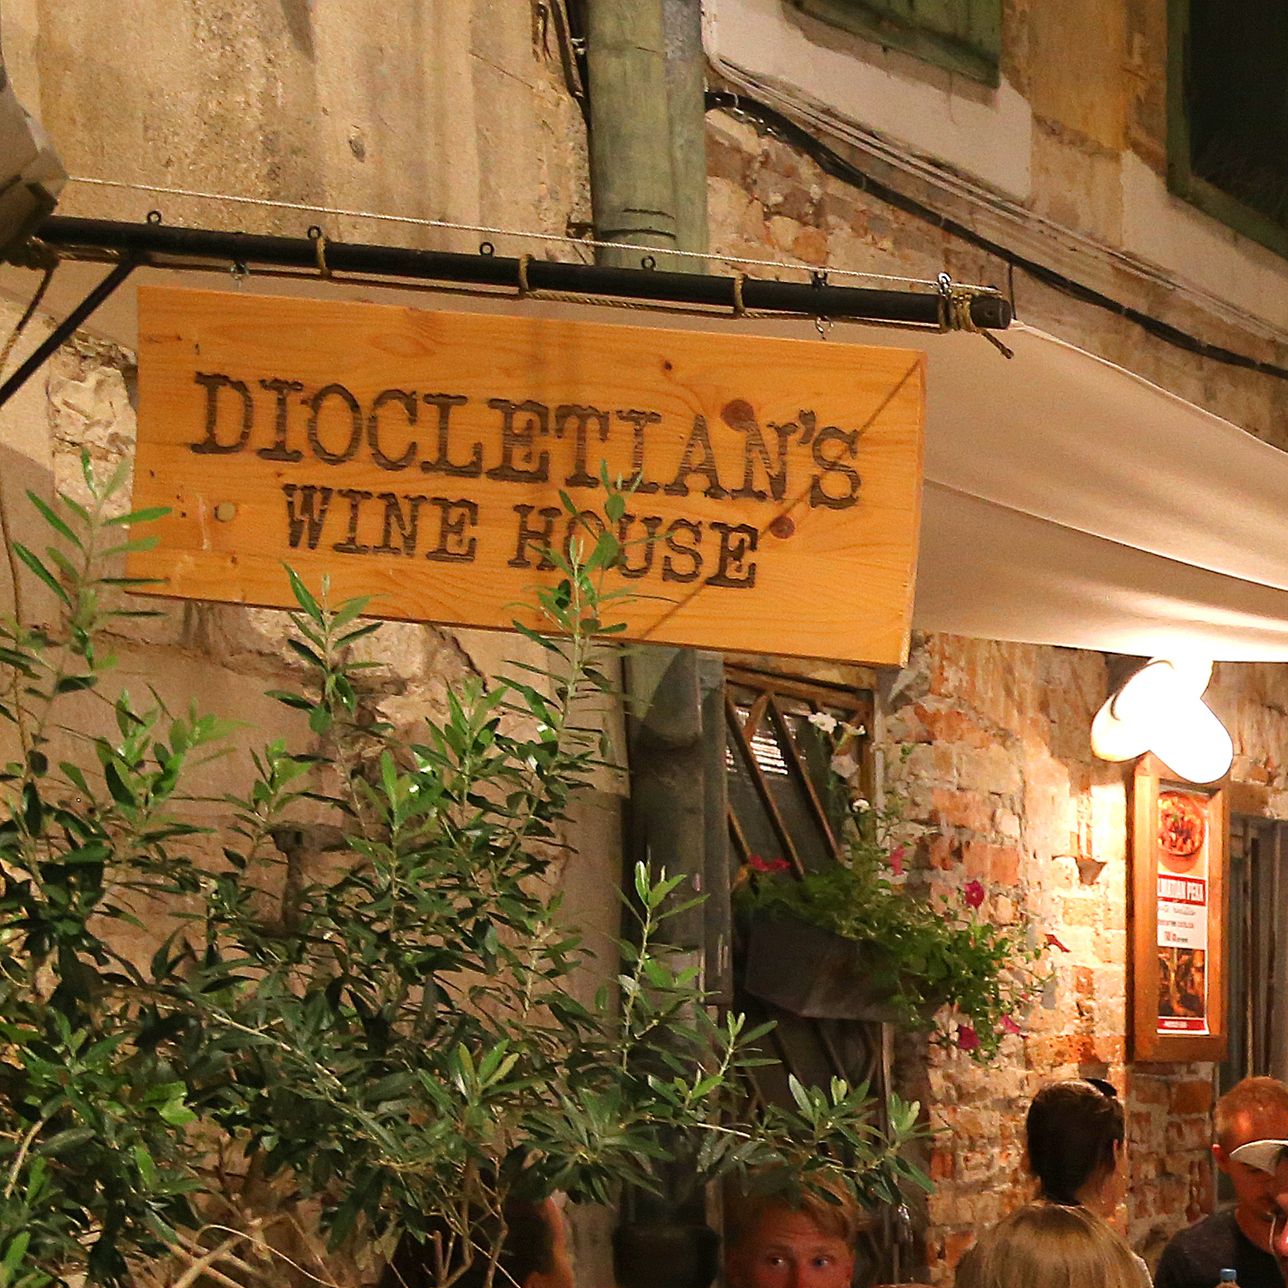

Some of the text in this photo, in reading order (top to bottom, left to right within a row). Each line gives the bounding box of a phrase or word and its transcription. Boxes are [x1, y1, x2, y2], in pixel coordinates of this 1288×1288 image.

[190, 370, 863, 511] DIOCLETIAN'S
[282, 483, 760, 590] WINE HOUSE
